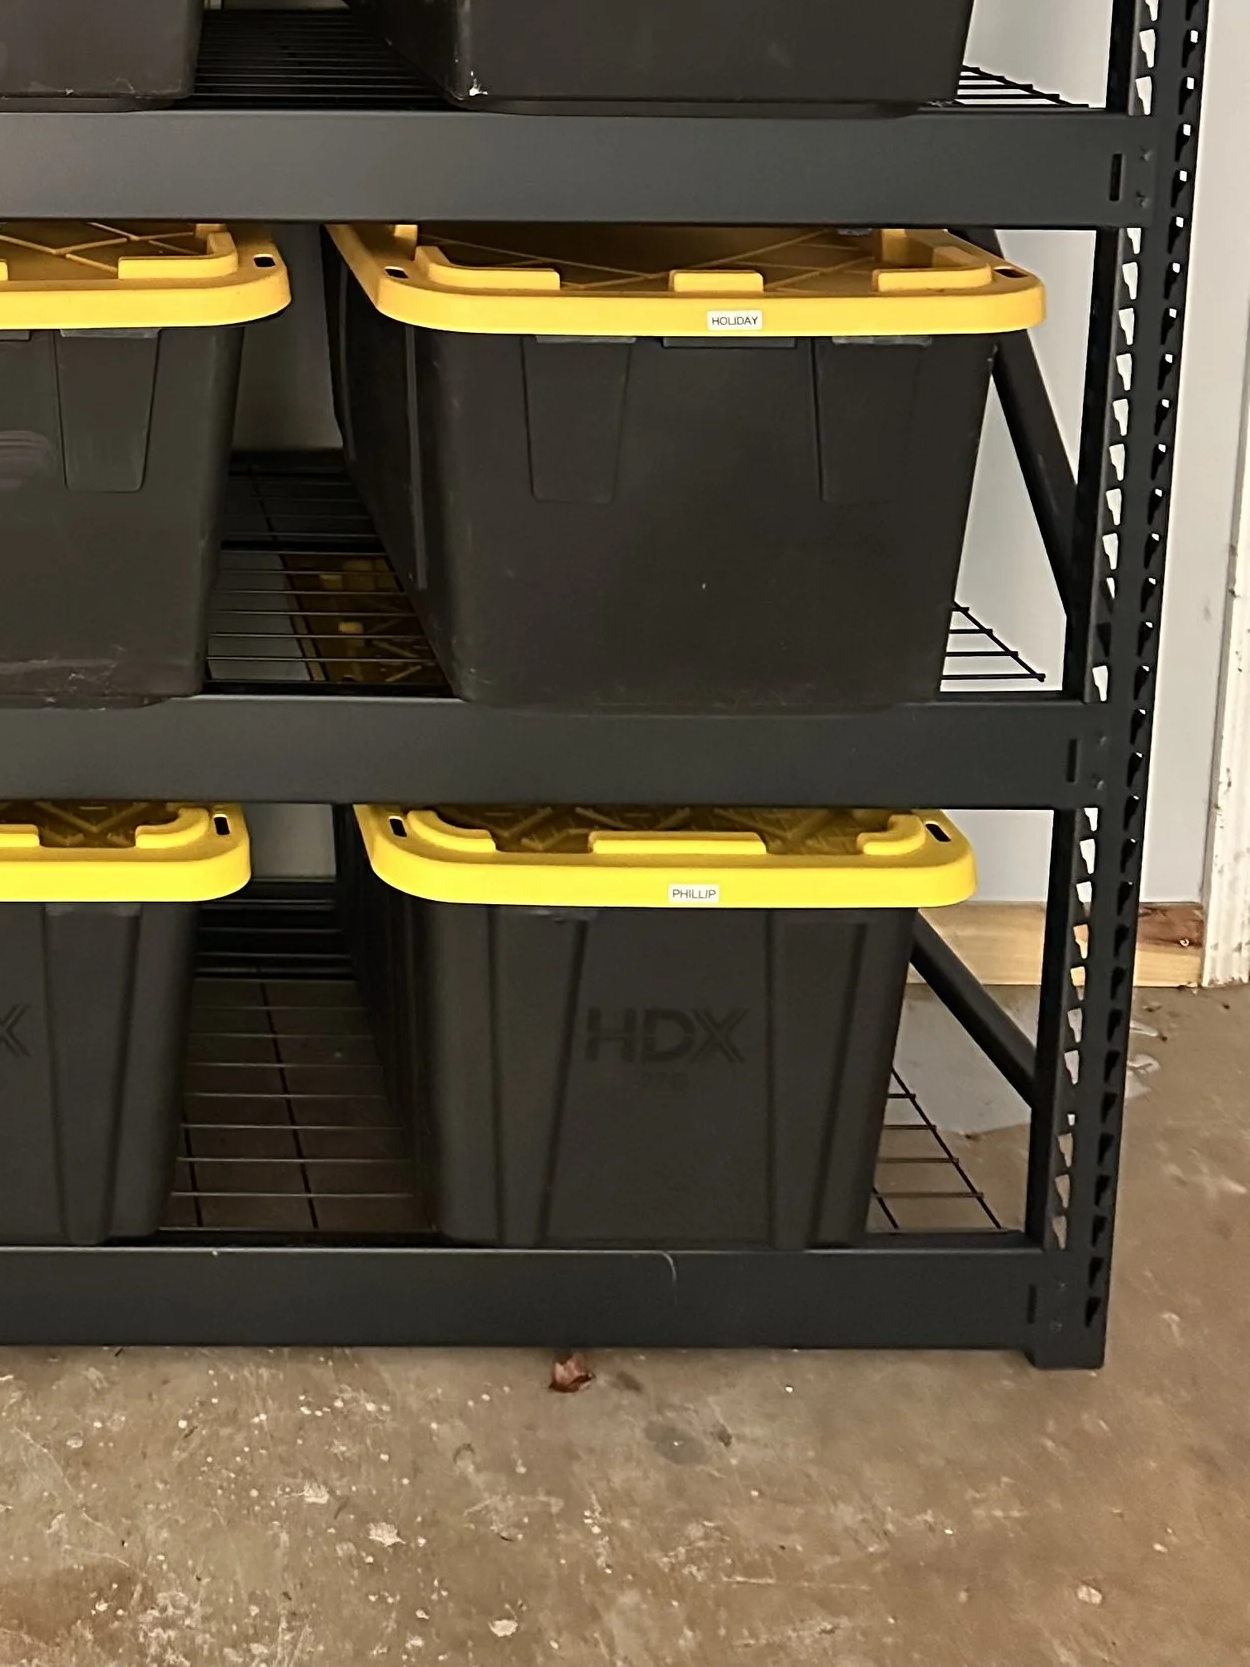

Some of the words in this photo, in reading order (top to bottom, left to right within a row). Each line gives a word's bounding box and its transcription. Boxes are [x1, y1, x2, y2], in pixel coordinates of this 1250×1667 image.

[711, 316, 758, 326] HOLIDAY
[671, 888, 717, 899] PHILLIP
[585, 1007, 749, 1064] HDX
